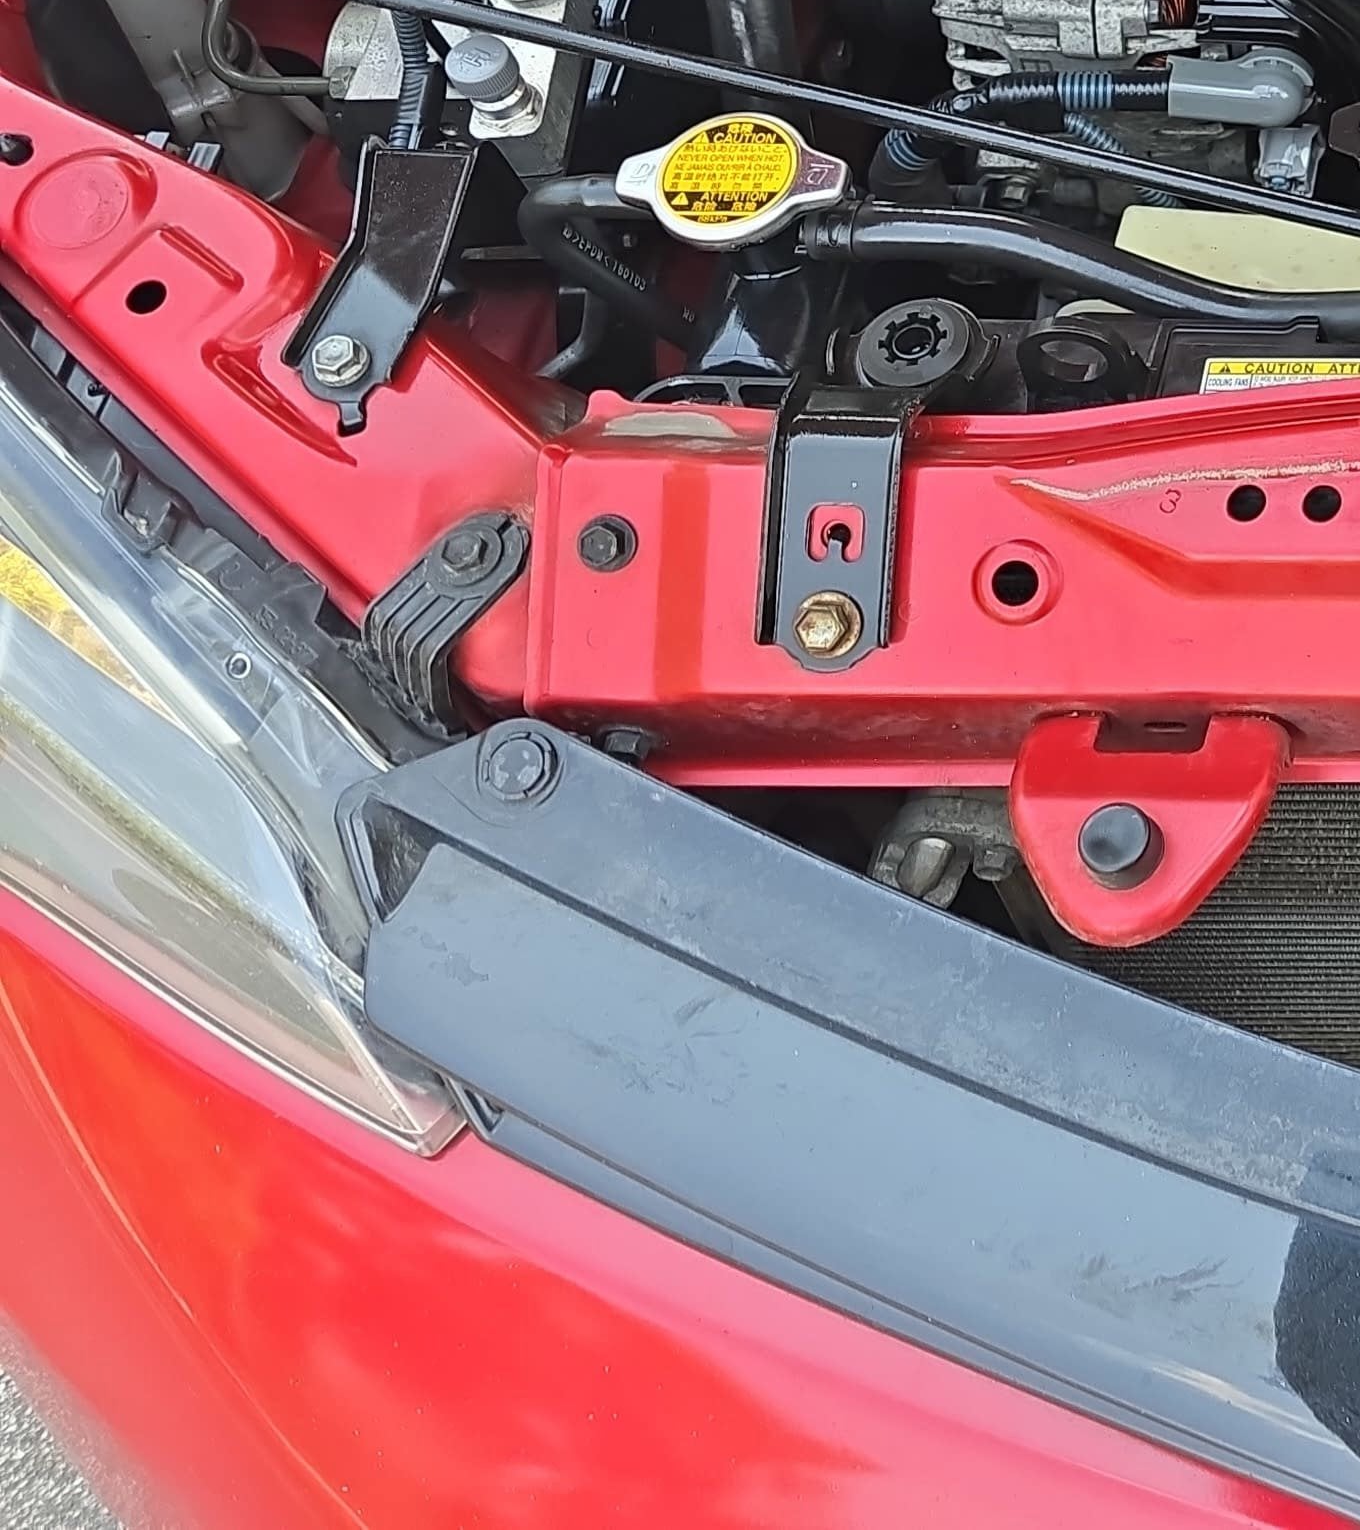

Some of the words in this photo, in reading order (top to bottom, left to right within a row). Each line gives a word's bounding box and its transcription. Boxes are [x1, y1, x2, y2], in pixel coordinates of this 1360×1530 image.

[713, 133, 777, 144] CAUTION
[677, 154, 708, 162] NEVER
[709, 154, 735, 162] OPEN
[735, 154, 763, 162] WHEN
[700, 191, 769, 201] ATTENTION
[1244, 363, 1314, 375] CAUTION
[1208, 378, 1233, 388] COOLING
[1234, 378, 1250, 388] FANS
